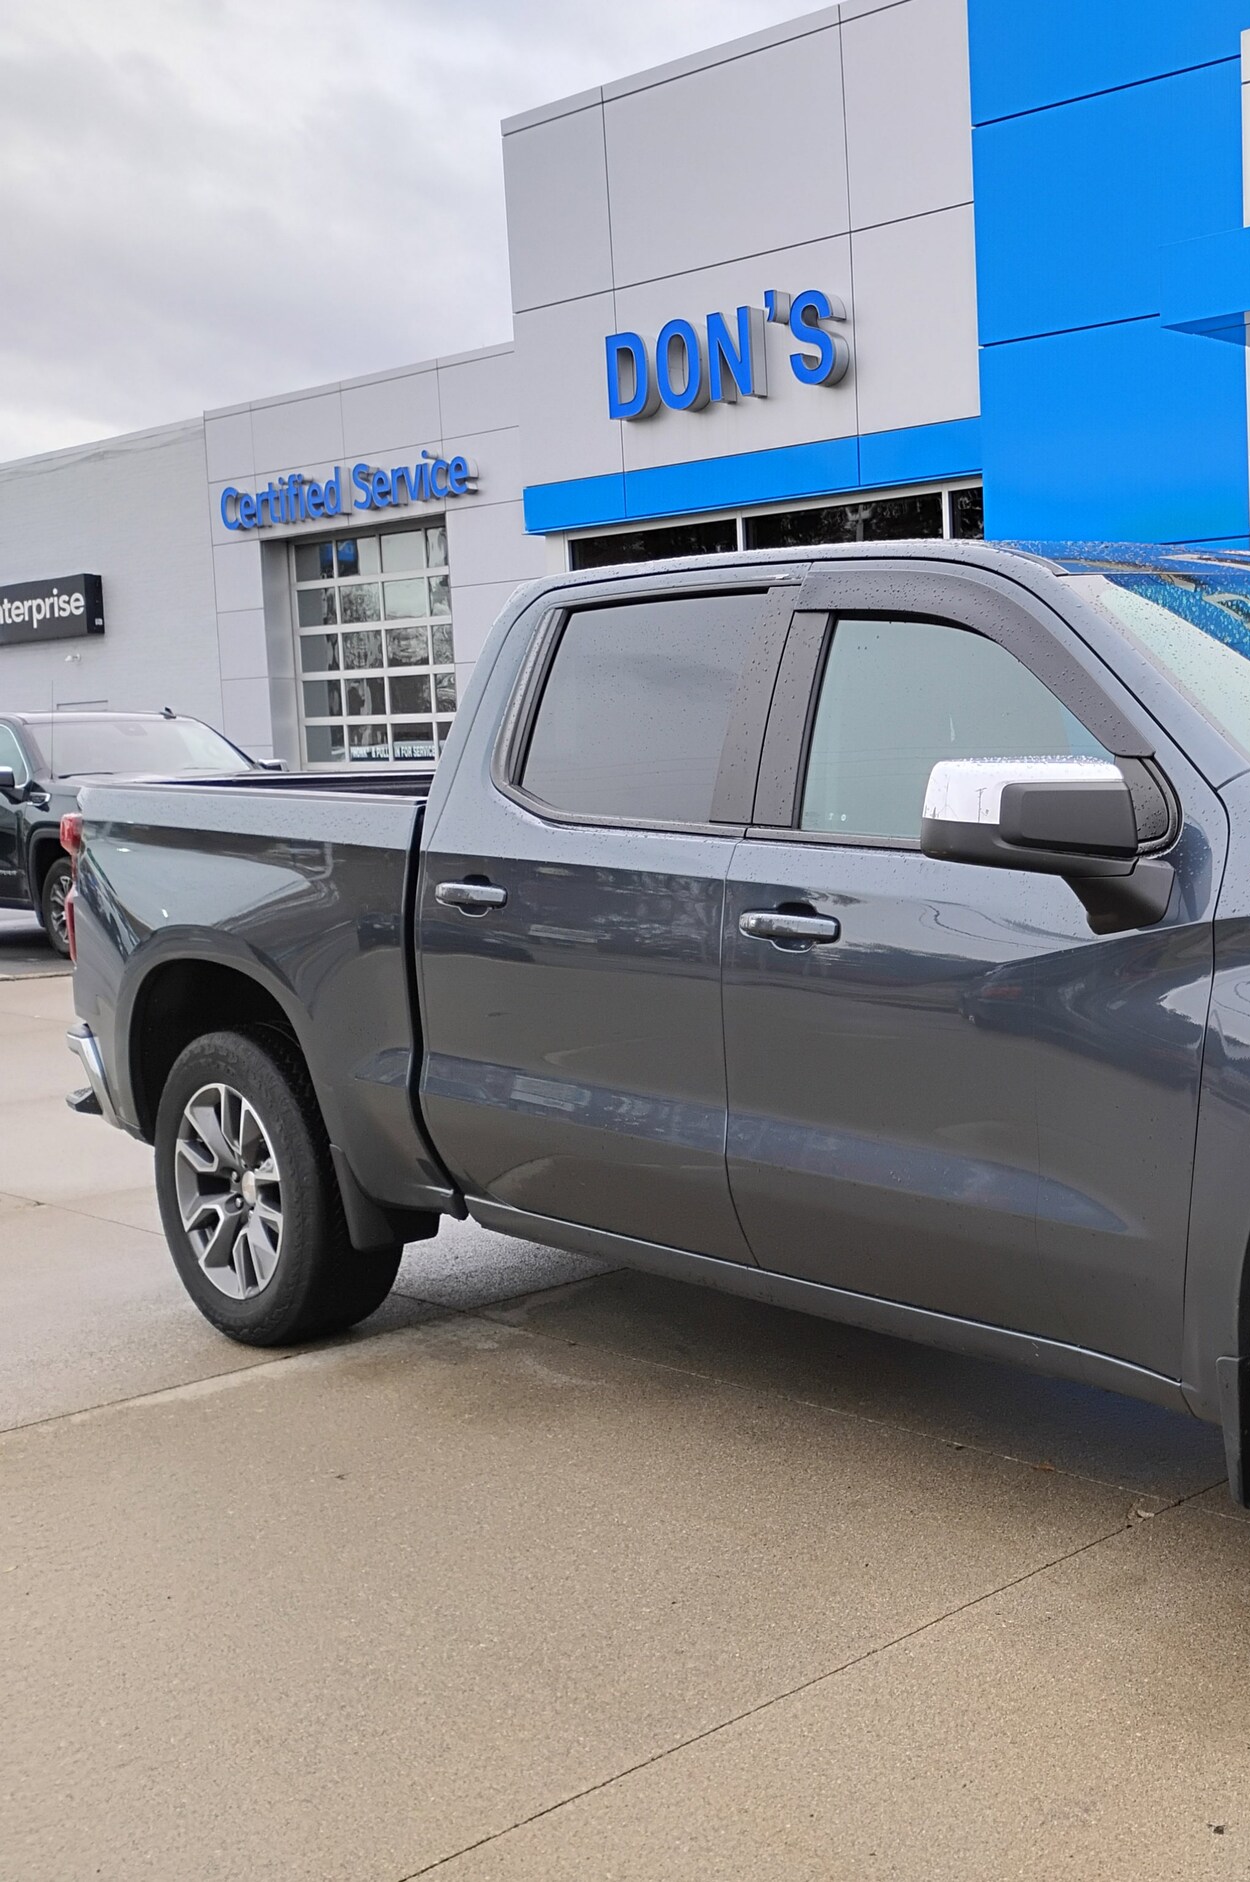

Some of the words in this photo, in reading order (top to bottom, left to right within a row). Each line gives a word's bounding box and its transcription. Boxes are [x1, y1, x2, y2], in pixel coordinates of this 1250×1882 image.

[605, 289, 845, 421] DON'S
[221, 466, 343, 531] Certified
[352, 450, 473, 511] Service
[0, 587, 85, 629] terprise
[402, 745, 413, 758] FOR
[413, 744, 435, 757] SERVICE
